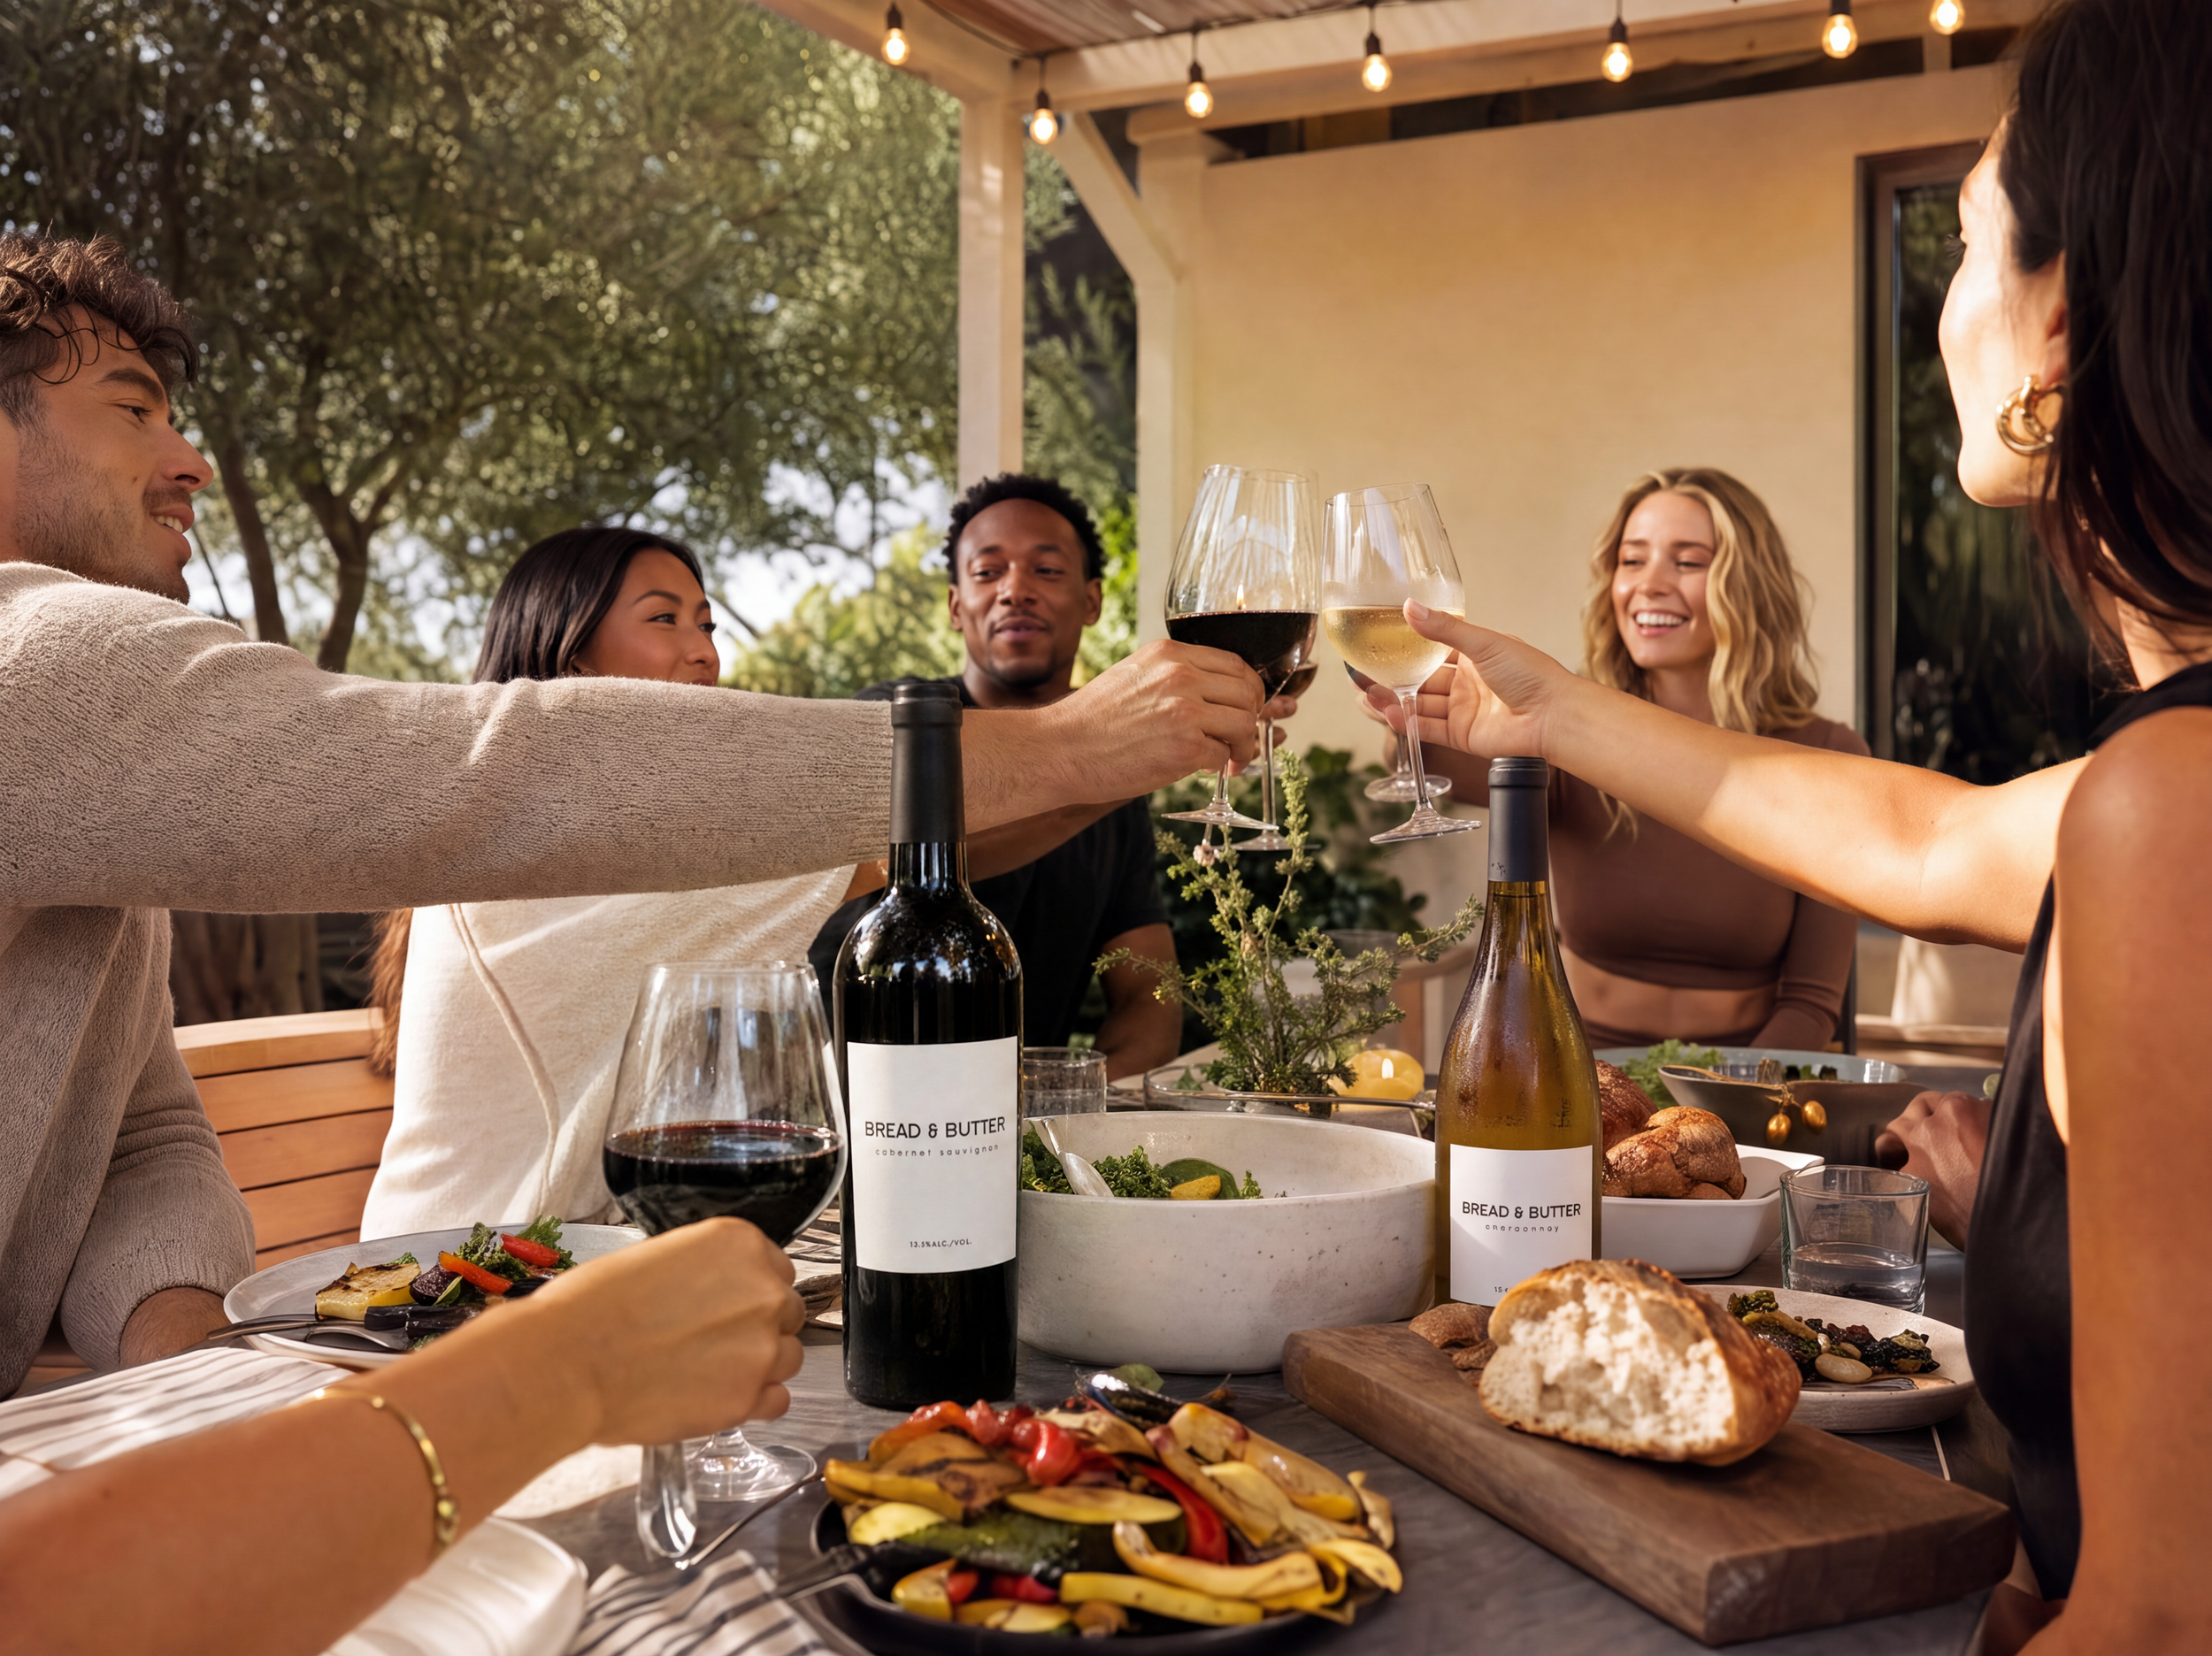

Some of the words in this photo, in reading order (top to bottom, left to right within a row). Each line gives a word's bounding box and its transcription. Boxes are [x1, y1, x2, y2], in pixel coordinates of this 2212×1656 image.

[864, 1121, 922, 1138] BREAD
[927, 1123, 938, 1139] &
[945, 1116, 1006, 1138] BUTTER
[875, 1148, 932, 1157] cabernet
[940, 1144, 999, 1156] sauvignon
[1462, 1200, 1509, 1218] BREAD
[1514, 1206, 1524, 1219] &
[1529, 1203, 1581, 1219] BUTTER
